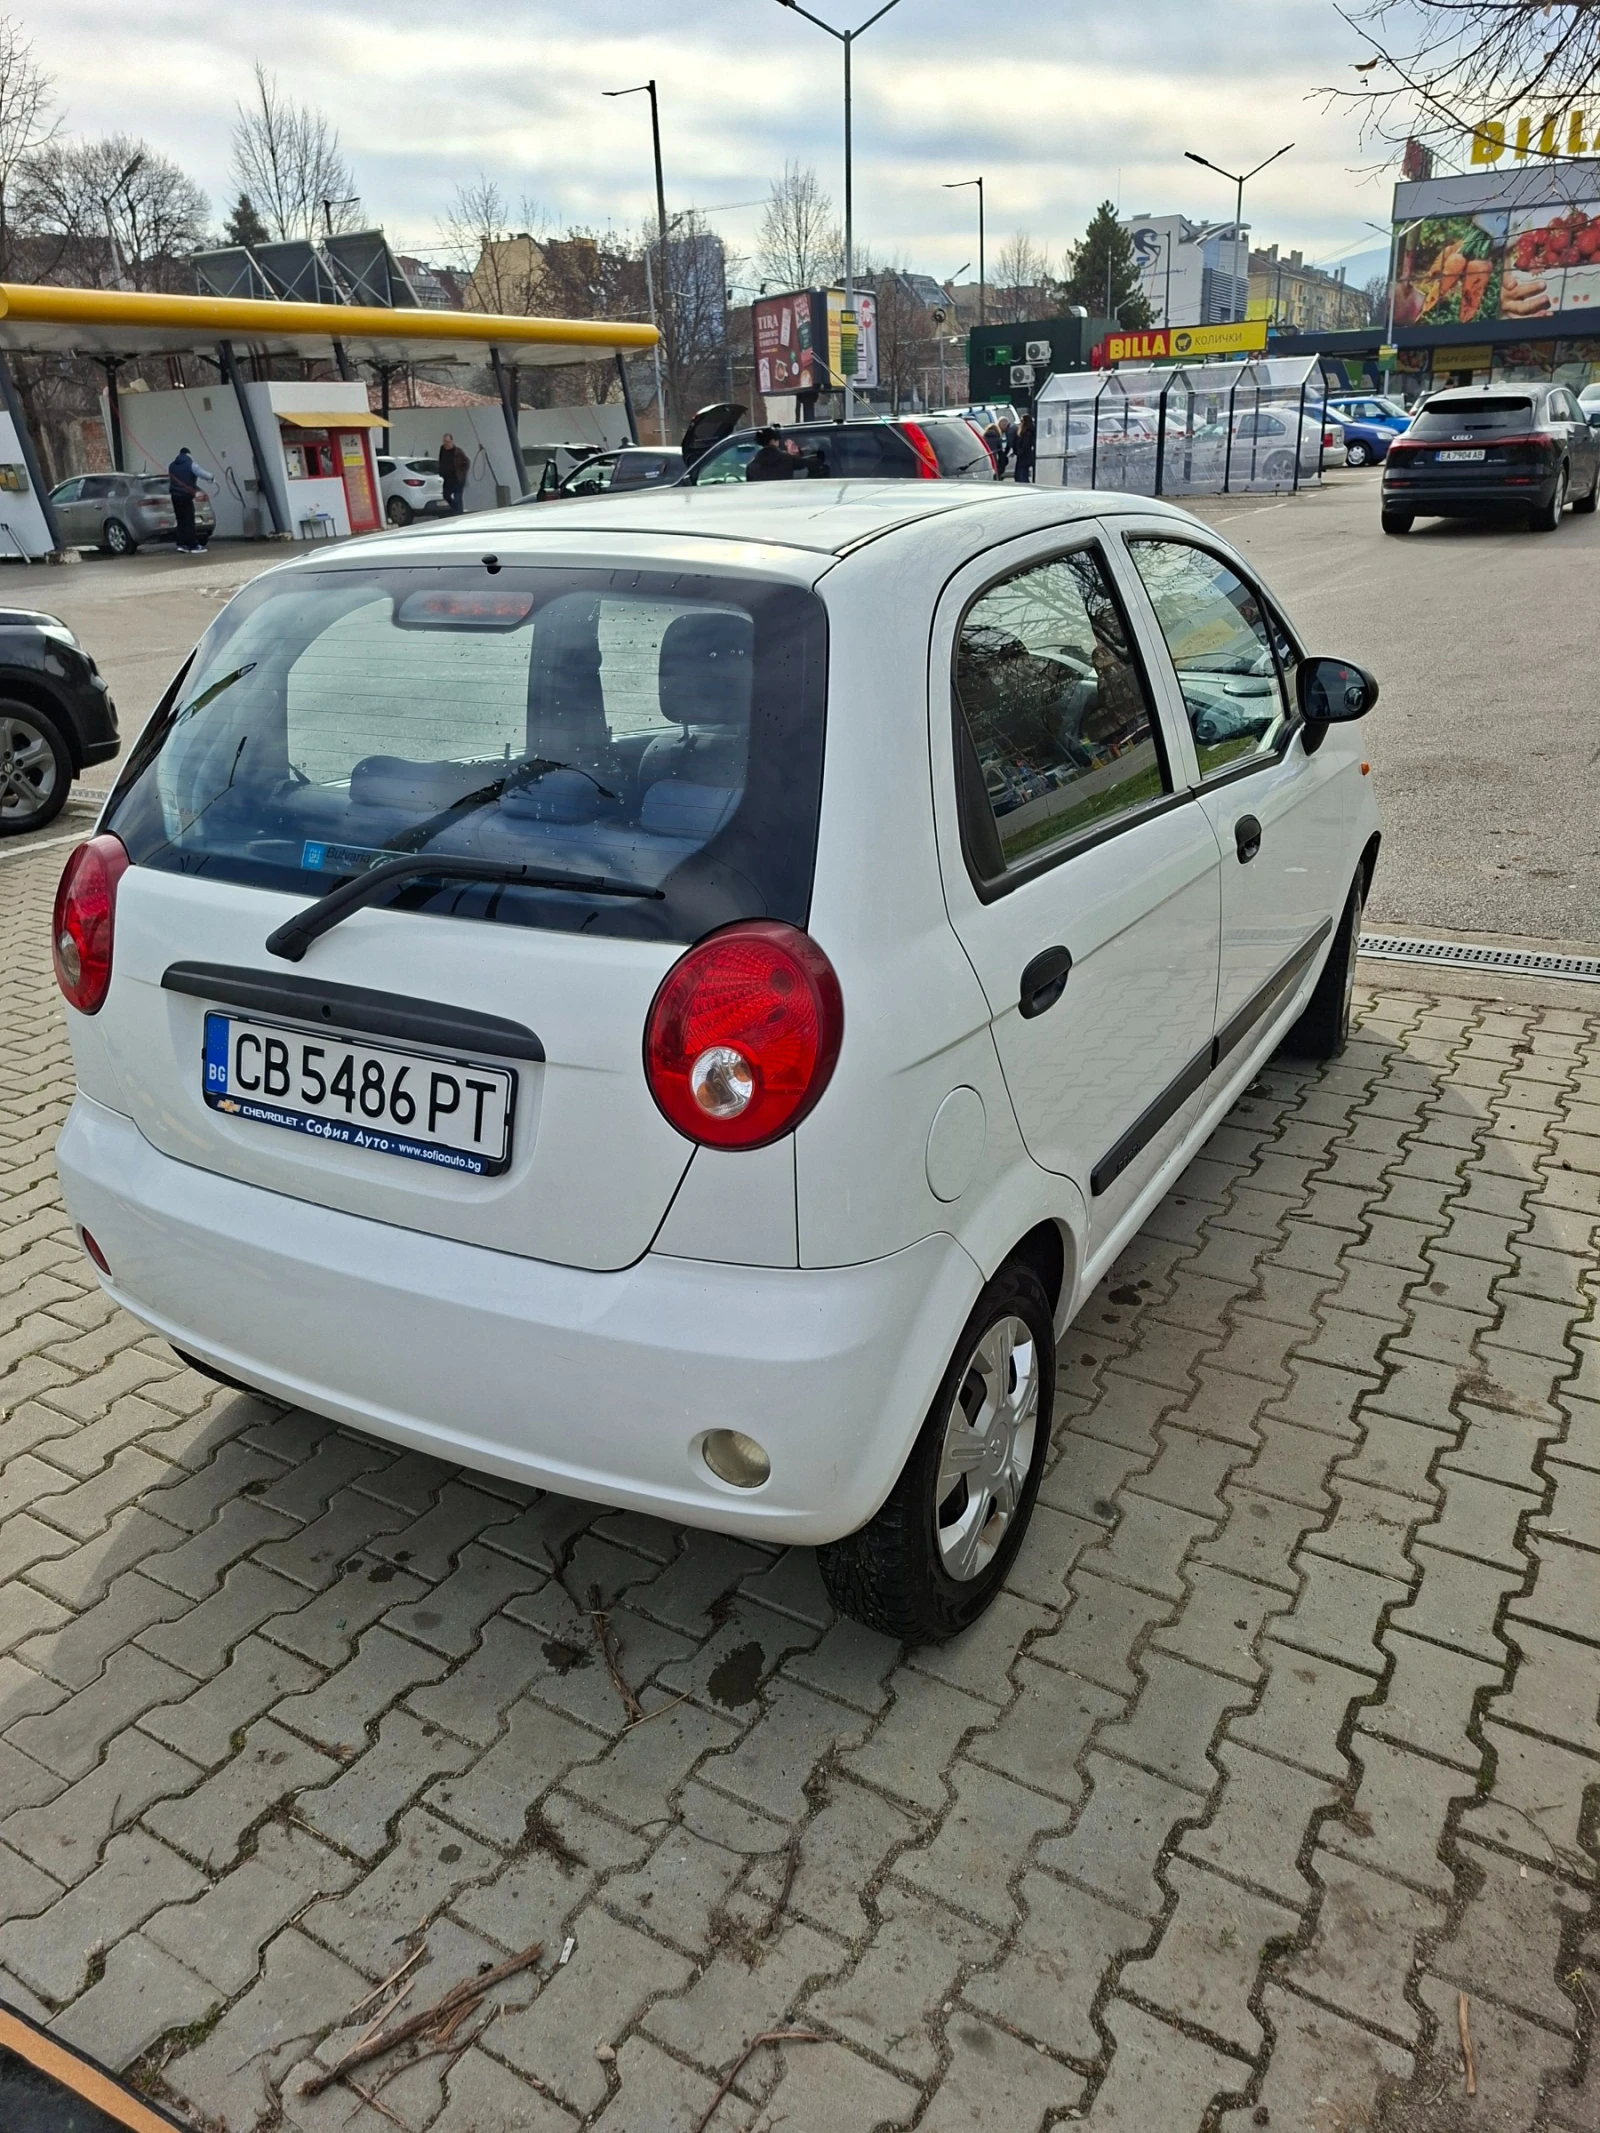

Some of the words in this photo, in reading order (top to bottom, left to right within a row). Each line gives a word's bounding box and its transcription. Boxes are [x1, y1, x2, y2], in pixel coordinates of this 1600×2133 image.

[1470, 109, 1600, 166] BILL
[1109, 334, 1167, 360] BILLA
[209, 1063, 226, 1082] BG
[242, 1106, 298, 1127] CHEVROLET
[306, 1119, 350, 1140] София
[354, 1131, 389, 1150] Ауто
[398, 1143, 482, 1173] www.sofiaauto.bg
